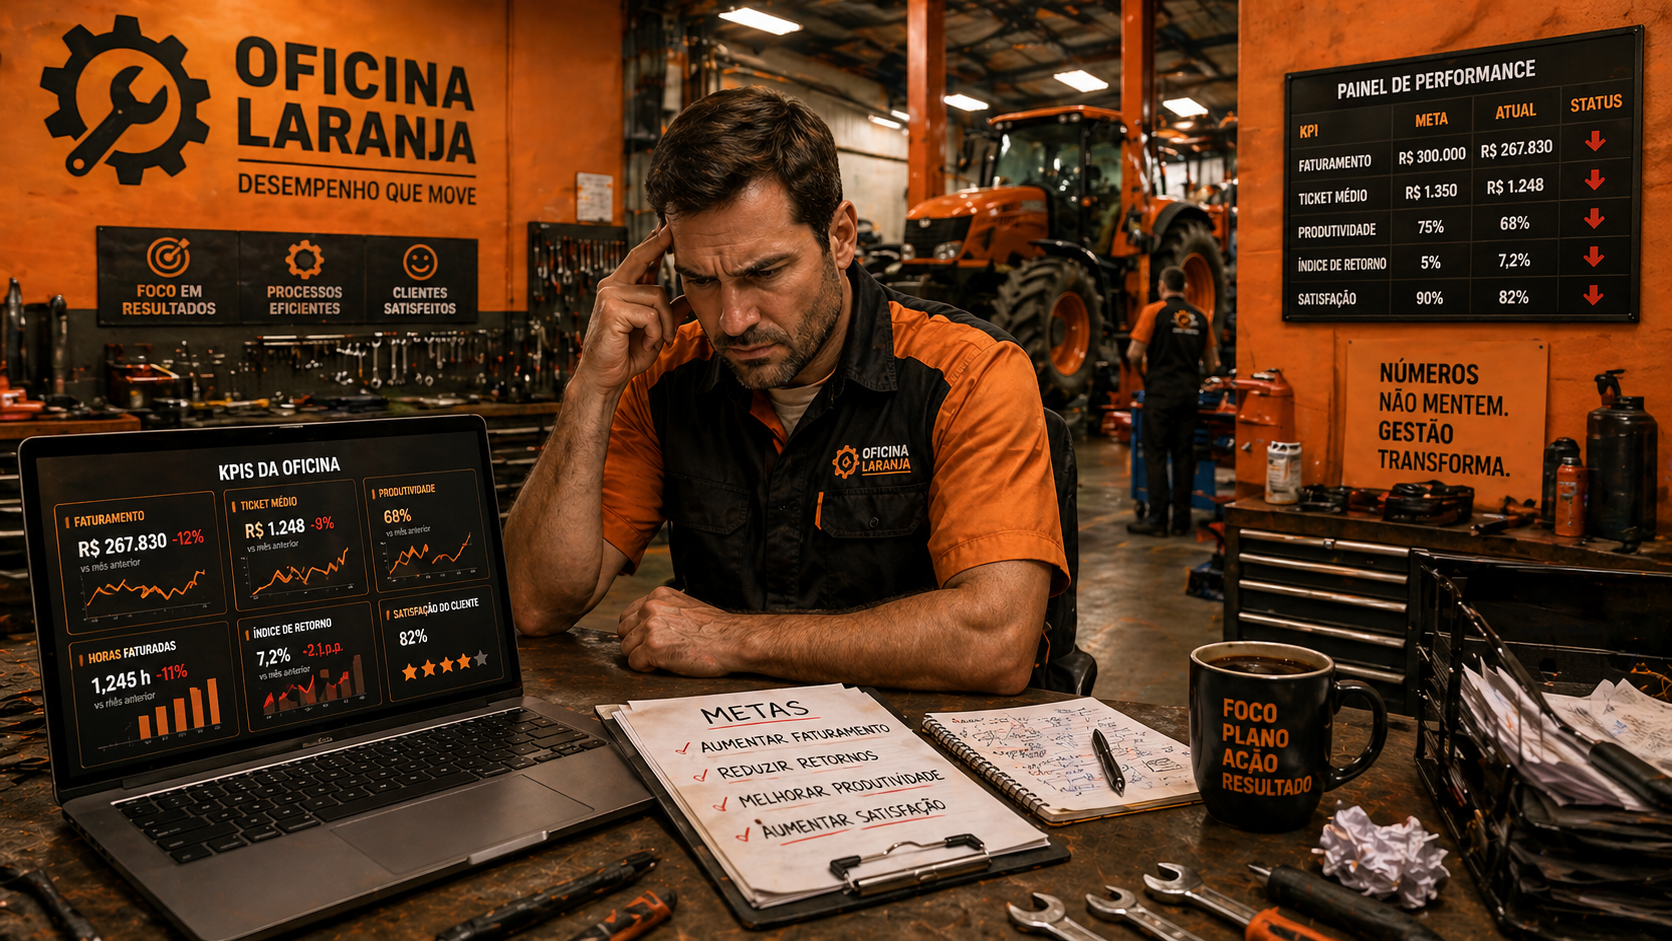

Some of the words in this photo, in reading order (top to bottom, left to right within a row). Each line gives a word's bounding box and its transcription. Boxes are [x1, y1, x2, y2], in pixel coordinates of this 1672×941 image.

[235, 36, 475, 112] OFICINA
[1337, 79, 1388, 99] PAINEL
[1392, 76, 1411, 93] DE
[1415, 59, 1536, 91] PERFORMANCE
[1495, 103, 1537, 120] ATUAL
[1570, 94, 1623, 113] STATUS
[1415, 112, 1448, 128] META
[238, 97, 476, 164] LARANJA
[1299, 124, 1319, 139] KPI
[1398, 150, 1414, 167] R$
[1416, 146, 1467, 164] 300.000
[1480, 143, 1498, 160] R$
[1500, 139, 1553, 157] 267.830
[1299, 154, 1372, 172] FATURAMENTO
[238, 173, 380, 201] DESEMPENHO
[385, 182, 422, 203] QUE
[428, 185, 477, 205] MOVE
[1299, 191, 1332, 206] TICKET
[1335, 186, 1367, 204] MÉDIO
[1405, 184, 1421, 201] R$
[1424, 183, 1458, 199] 1.350
[1486, 178, 1504, 196] R$
[1507, 177, 1544, 194] 1.248
[1298, 223, 1376, 239] PRODUTIVIDADE
[1417, 220, 1444, 234] 75%
[1499, 216, 1530, 231] 68%
[1298, 255, 1328, 273] ÍNDICE
[1330, 258, 1341, 271] DE
[1343, 256, 1387, 271] RETORNO
[1420, 255, 1441, 270] 5%
[1498, 253, 1531, 270] 7,2%
[137, 284, 176, 299] FOCO
[180, 284, 202, 298] EM
[267, 285, 343, 300] PROCESSOS
[392, 286, 448, 300] CLIENTES
[1298, 289, 1357, 308] SATISFAÇÃO
[1416, 291, 1444, 305] 90%
[1498, 289, 1529, 304] 82%
[122, 301, 216, 316] RESULTADOS
[269, 301, 341, 316] EFICIENTES
[384, 302, 456, 316] SATISFEITOS
[1380, 358, 1479, 385] NÚMEROS
[1379, 389, 1416, 414] NÃO
[1423, 393, 1509, 417] MENTEM.
[1378, 419, 1454, 445] GESTÃO
[862, 444, 909, 459] OFICINA
[218, 462, 254, 481] KPIS
[258, 460, 279, 478] DA
[282, 456, 341, 477] OFICINA
[862, 458, 911, 471] LARANJA
[1378, 449, 1510, 478] TRANSFORMA.
[379, 484, 436, 498] PRODUTIVIDADE
[241, 499, 269, 511] TICKET
[271, 495, 298, 508] MÉDIO
[74, 510, 145, 528] FATURAMENTO
[383, 507, 412, 524] 68%
[245, 521, 265, 540] R$
[267, 518, 305, 536] 1.248
[310, 515, 335, 530] -9%
[78, 538, 100, 559] R$
[104, 532, 167, 555] 267.830
[172, 529, 204, 546] -12%
[393, 602, 438, 619] SATISFAÇÃO
[439, 602, 450, 612] DO
[451, 597, 479, 610] CLIENTE
[253, 626, 281, 639] ÍNDICE
[282, 623, 293, 634] DE
[295, 618, 332, 632] RETORNO
[399, 628, 428, 647] 82%
[88, 649, 122, 664] HORAS
[123, 640, 177, 659] FATURADAS
[256, 647, 291, 668] 7,2%
[91, 671, 137, 695] 1,245
[140, 669, 151, 686] h
[156, 663, 188, 681] -11%
[700, 700, 809, 725] METAS
[1222, 698, 1277, 724] FOCO
[701, 733, 789, 753] AUMENTAR
[791, 723, 891, 742] FATURAMENTO
[1222, 723, 1289, 748] PLANO
[717, 760, 794, 779] REDUZIR
[796, 750, 879, 769] RETORNOS
[738, 785, 831, 809] MELHORAR
[831, 769, 945, 795] PRODUTIVIDADE
[1222, 772, 1312, 796] RESULTADO
[762, 813, 855, 839] AUMENTAR
[855, 797, 946, 824] SATISFAÇÃO
